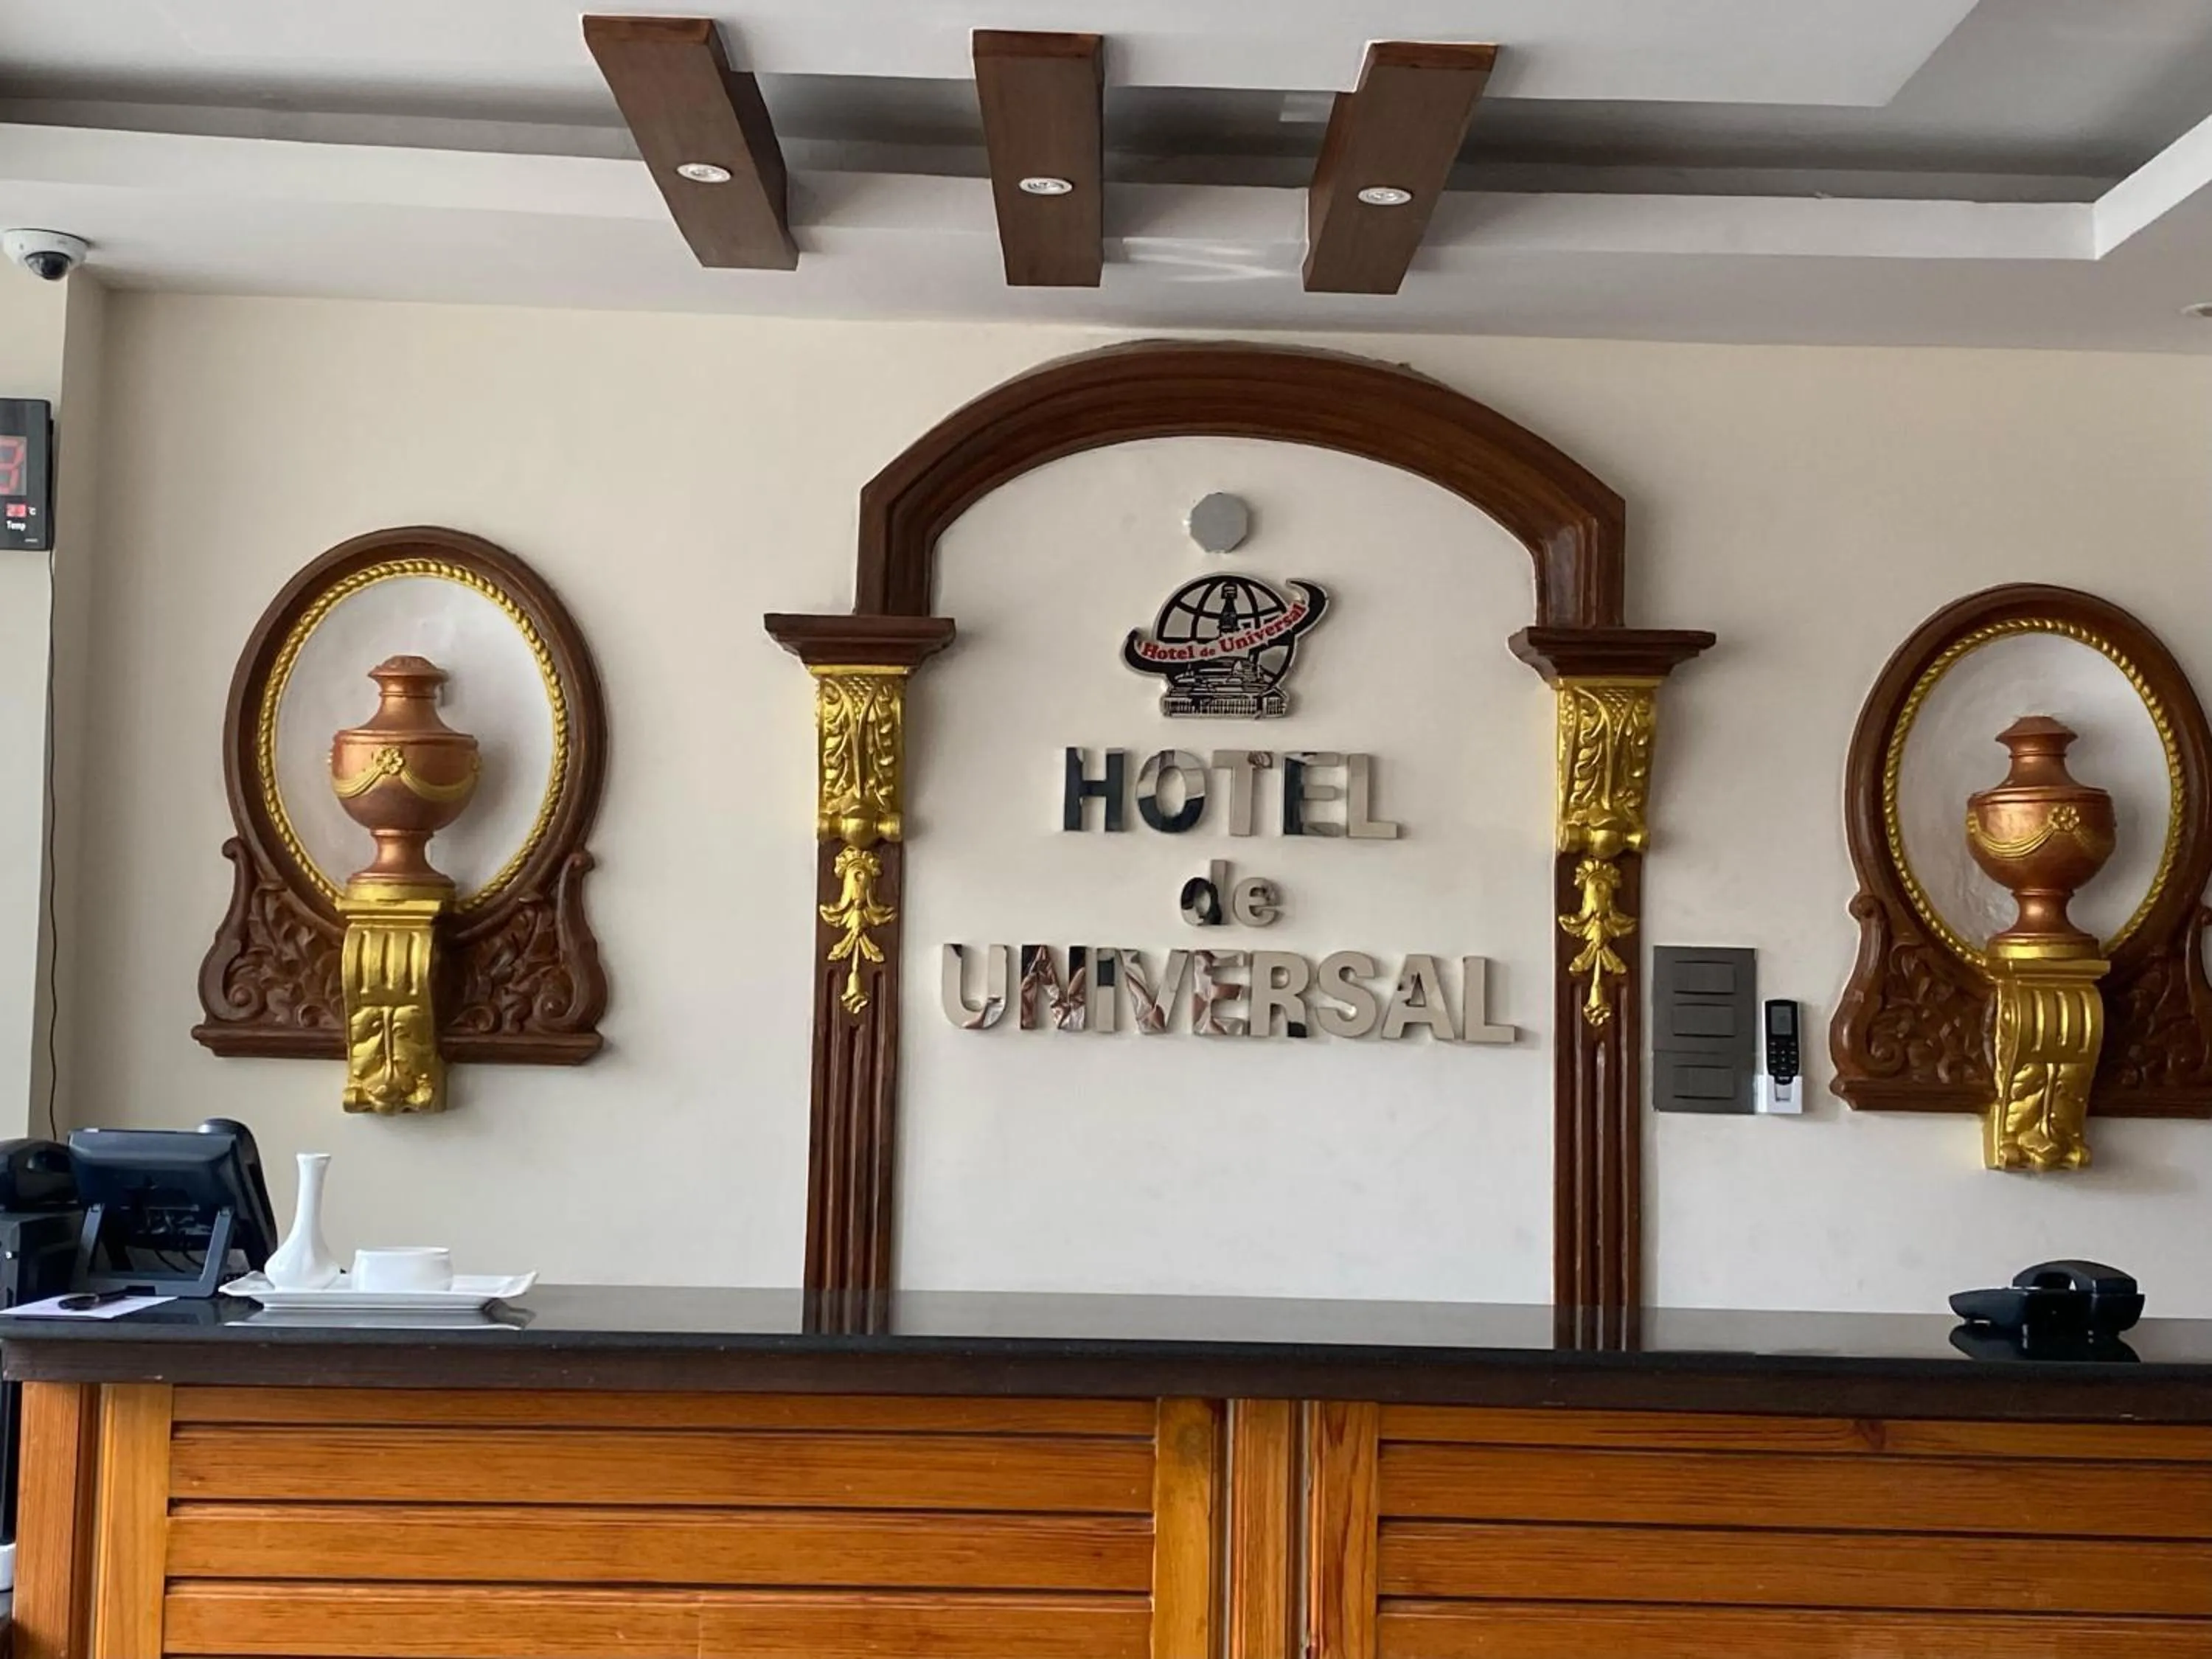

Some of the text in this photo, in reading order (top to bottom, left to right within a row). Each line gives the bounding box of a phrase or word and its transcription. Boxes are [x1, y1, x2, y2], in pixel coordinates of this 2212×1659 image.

[7, 520, 27, 531] Temp
[1141, 603, 1306, 660] Hotel de Universal
[1062, 746, 1399, 839] HOTEL
[1180, 859, 1284, 928] de
[941, 943, 1517, 1044] UNIVERSAL
